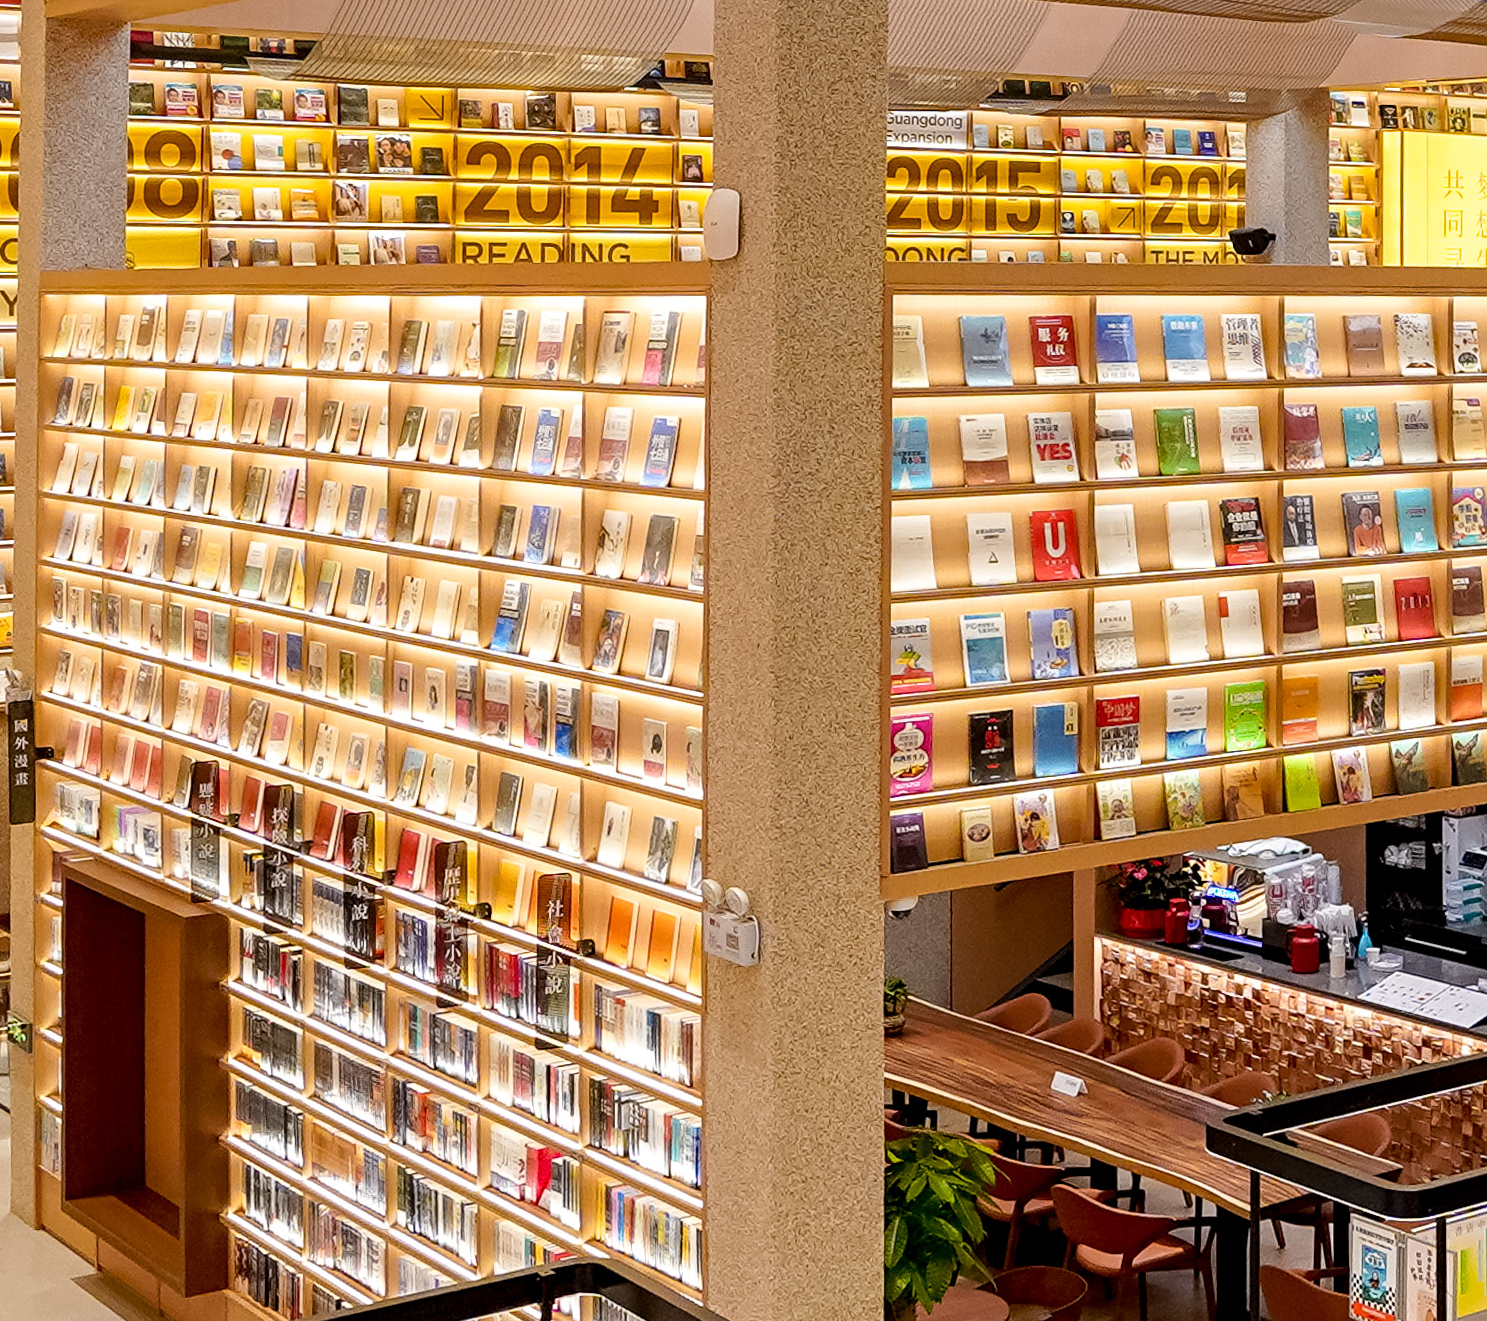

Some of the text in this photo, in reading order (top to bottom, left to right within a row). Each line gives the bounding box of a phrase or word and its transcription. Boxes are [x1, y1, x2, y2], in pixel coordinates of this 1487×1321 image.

[462, 140, 660, 225] 2014
[887, 156, 1042, 233] 2015
[1035, 441, 1074, 463] YES
